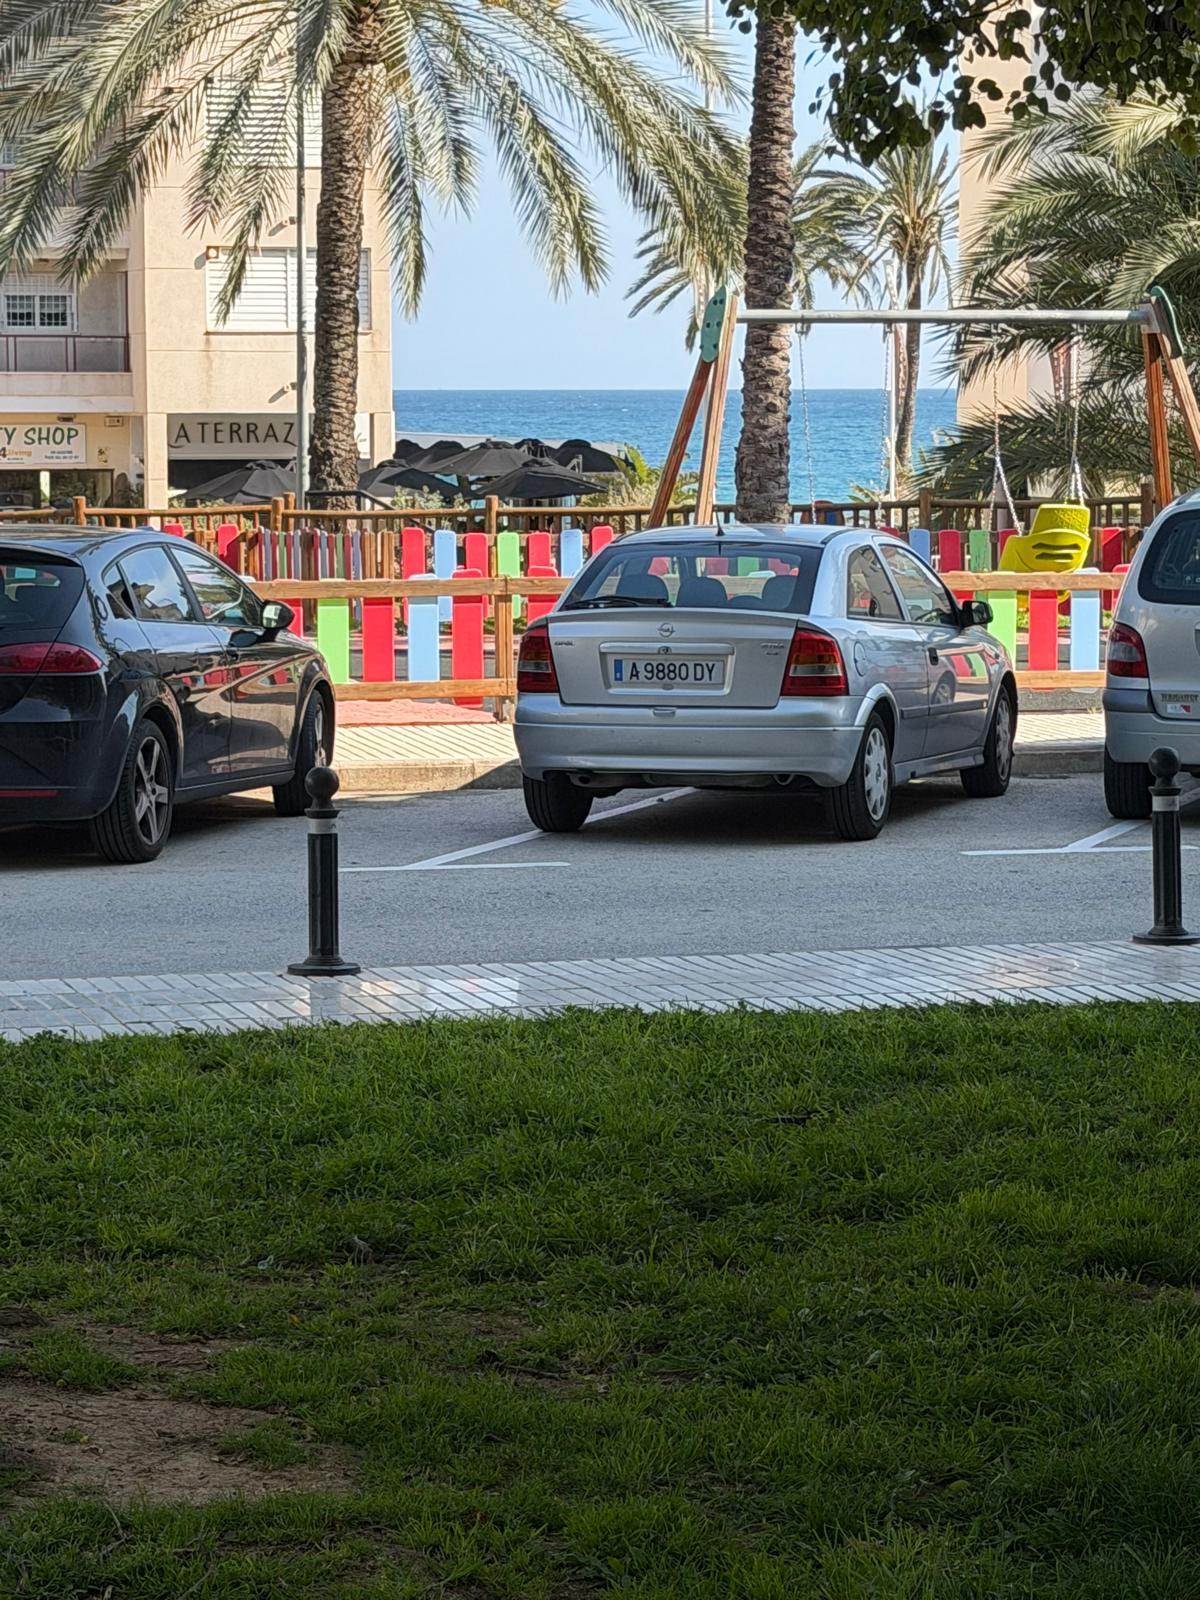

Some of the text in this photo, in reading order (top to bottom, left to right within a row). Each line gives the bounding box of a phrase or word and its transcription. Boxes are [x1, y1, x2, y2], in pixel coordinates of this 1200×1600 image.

[23, 427, 79, 445] SHOP
[629, 662, 716, 682] A 9880 DY
